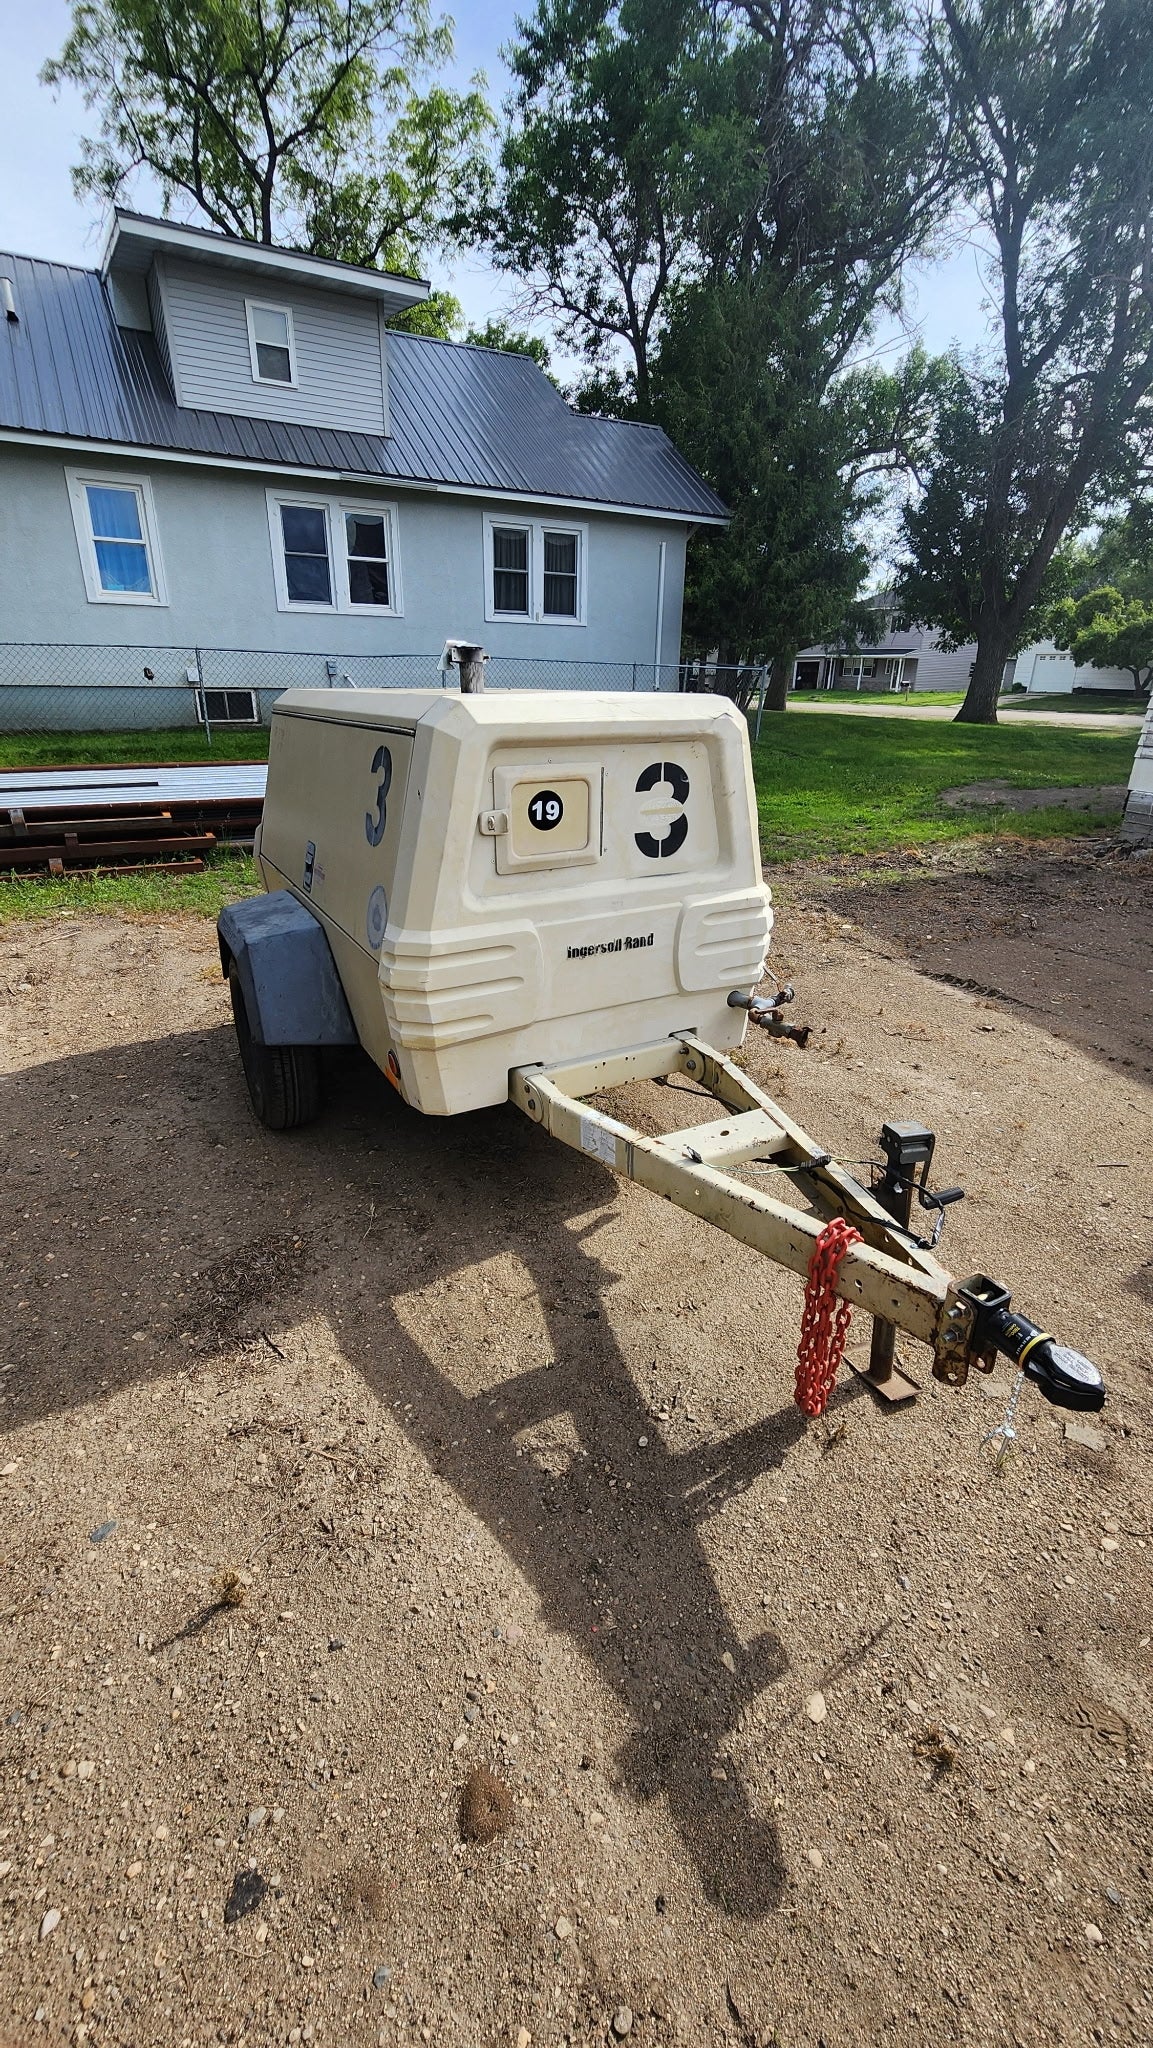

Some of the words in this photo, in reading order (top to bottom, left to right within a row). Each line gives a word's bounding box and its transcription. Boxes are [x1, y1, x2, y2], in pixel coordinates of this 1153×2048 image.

[366, 745, 392, 847] 3
[531, 800, 560, 821] 19
[634, 762, 690, 858] 3
